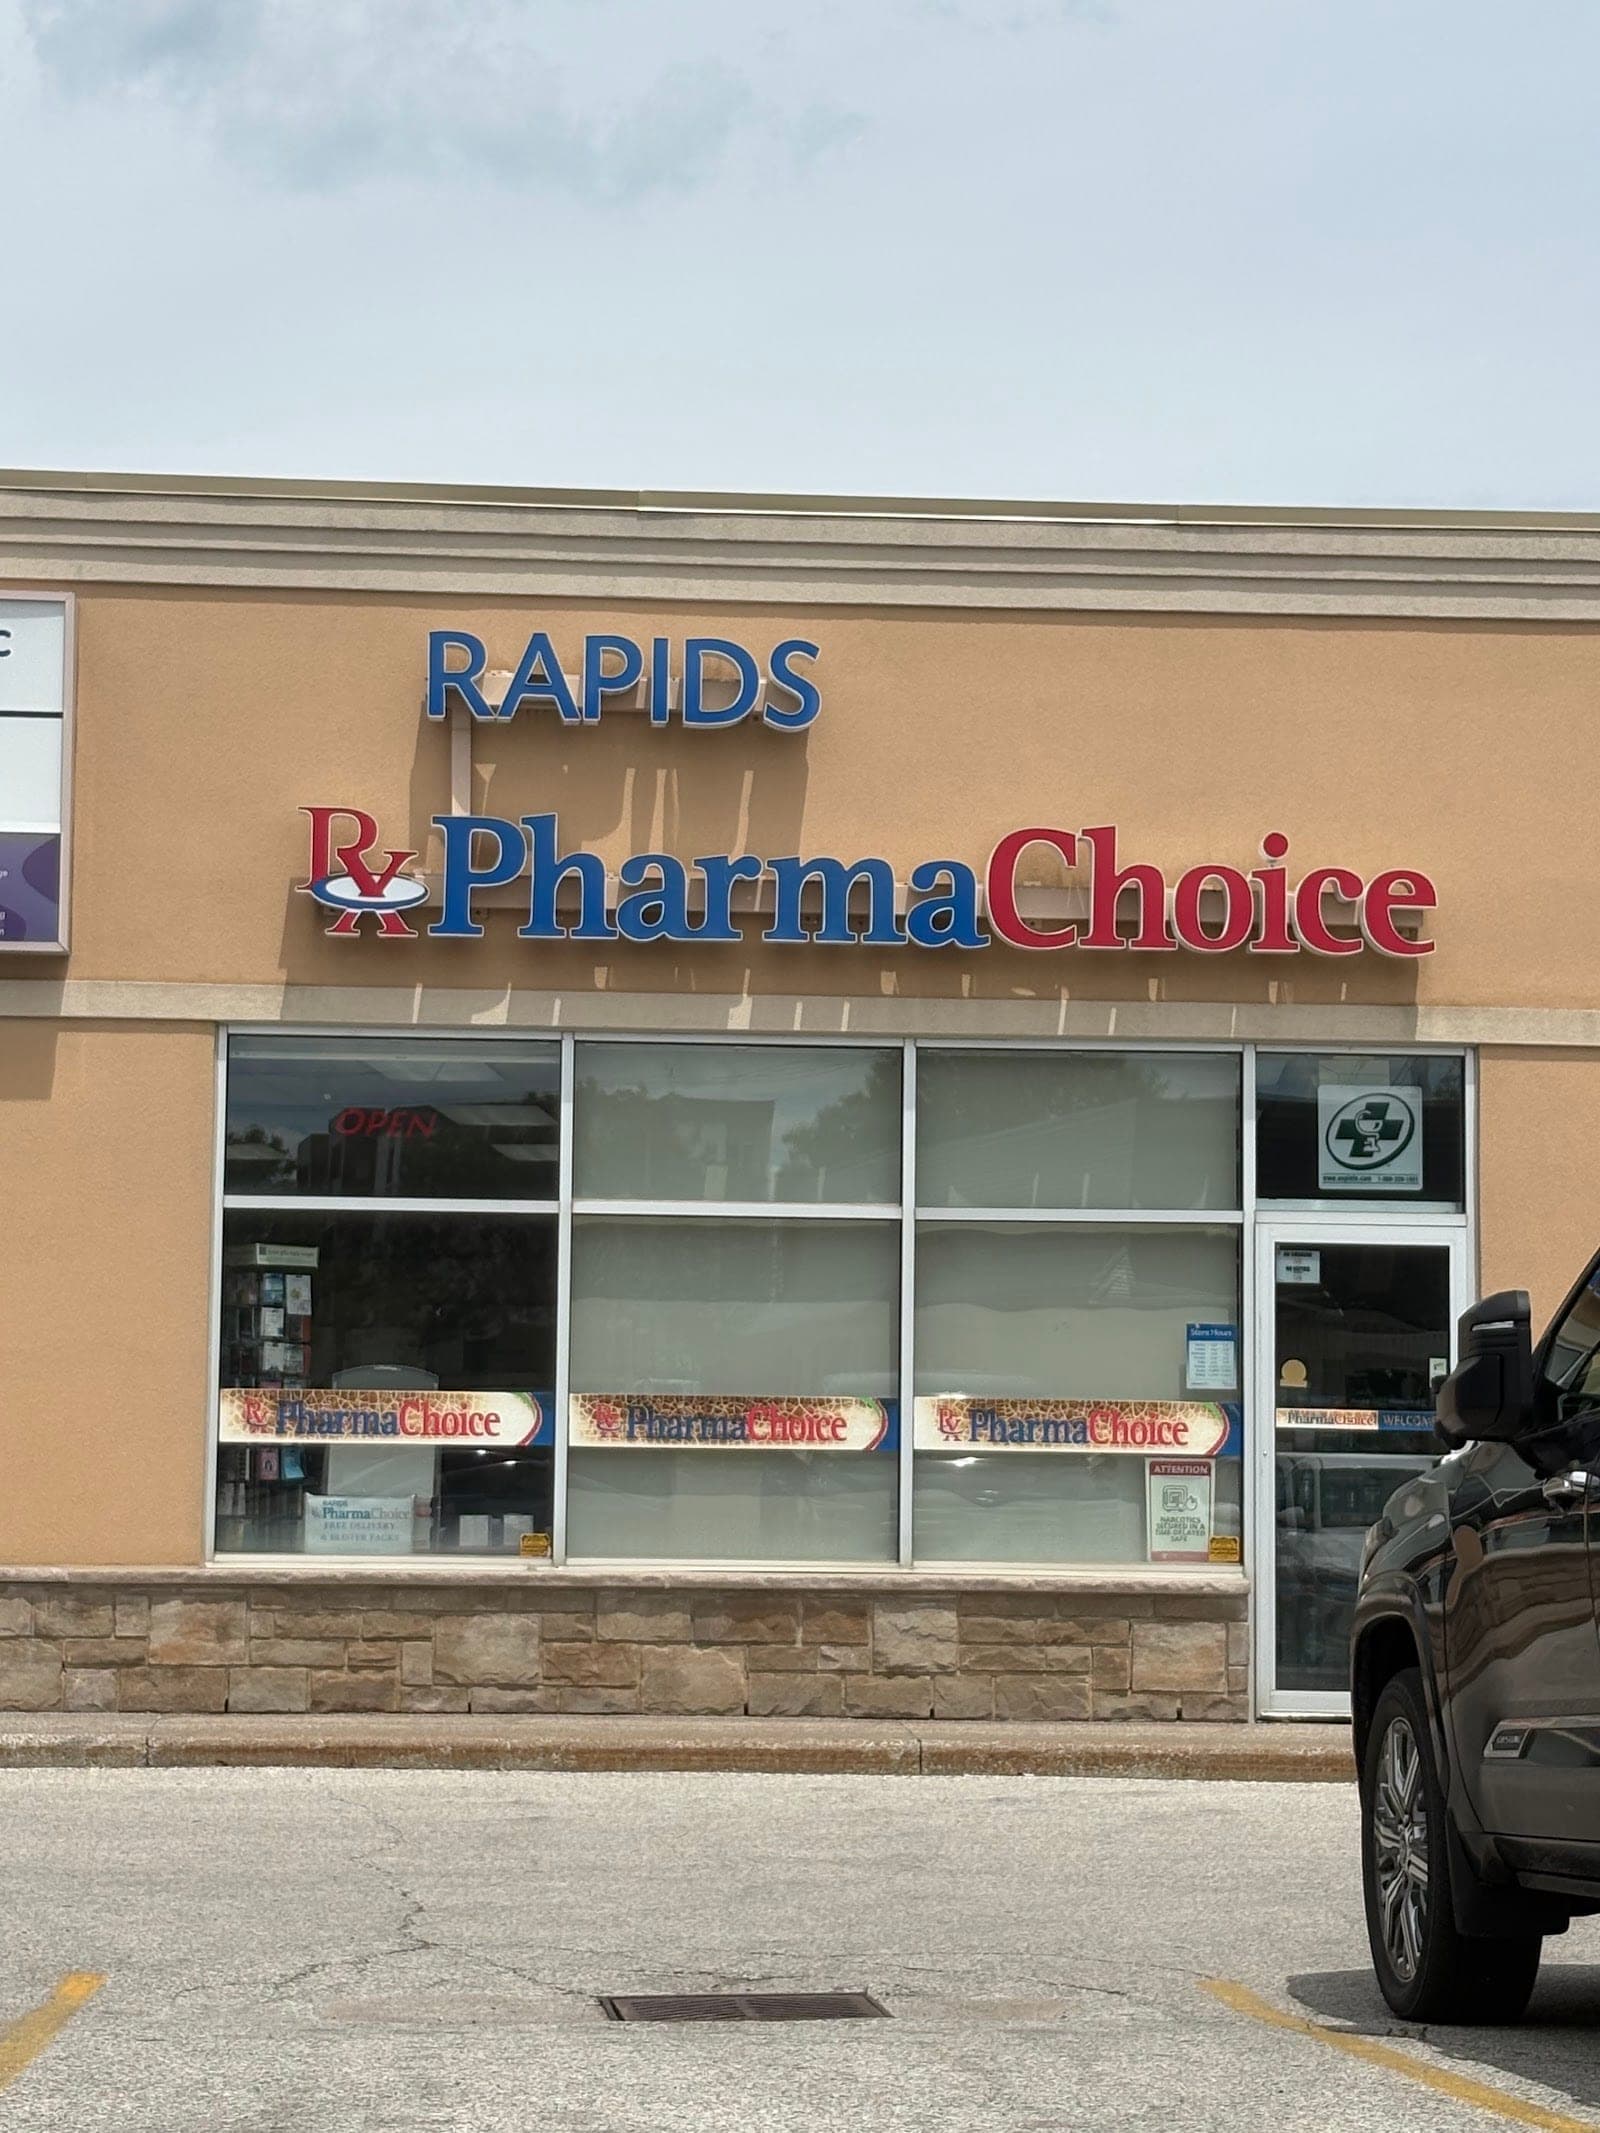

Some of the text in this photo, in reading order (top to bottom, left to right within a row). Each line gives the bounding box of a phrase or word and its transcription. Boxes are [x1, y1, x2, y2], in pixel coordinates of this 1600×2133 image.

[426, 630, 822, 732] RAPIDS
[428, 813, 1438, 957] PharmaChoice
[336, 1107, 437, 1137] OPEN
[276, 1399, 501, 1437] PharmaChoice
[626, 1403, 848, 1442] PharmaChoice
[967, 1406, 1189, 1446] PharmaChoice
[1287, 1411, 1376, 1426] PharmaChoice
[1382, 1415, 1434, 1427] WELCOM
[1154, 1464, 1209, 1474] ATTENTION
[322, 1507, 411, 1520] PharmaChoice
[1160, 1516, 1202, 1524] NARCOTICS
[1156, 1522, 1187, 1530] SECURED
